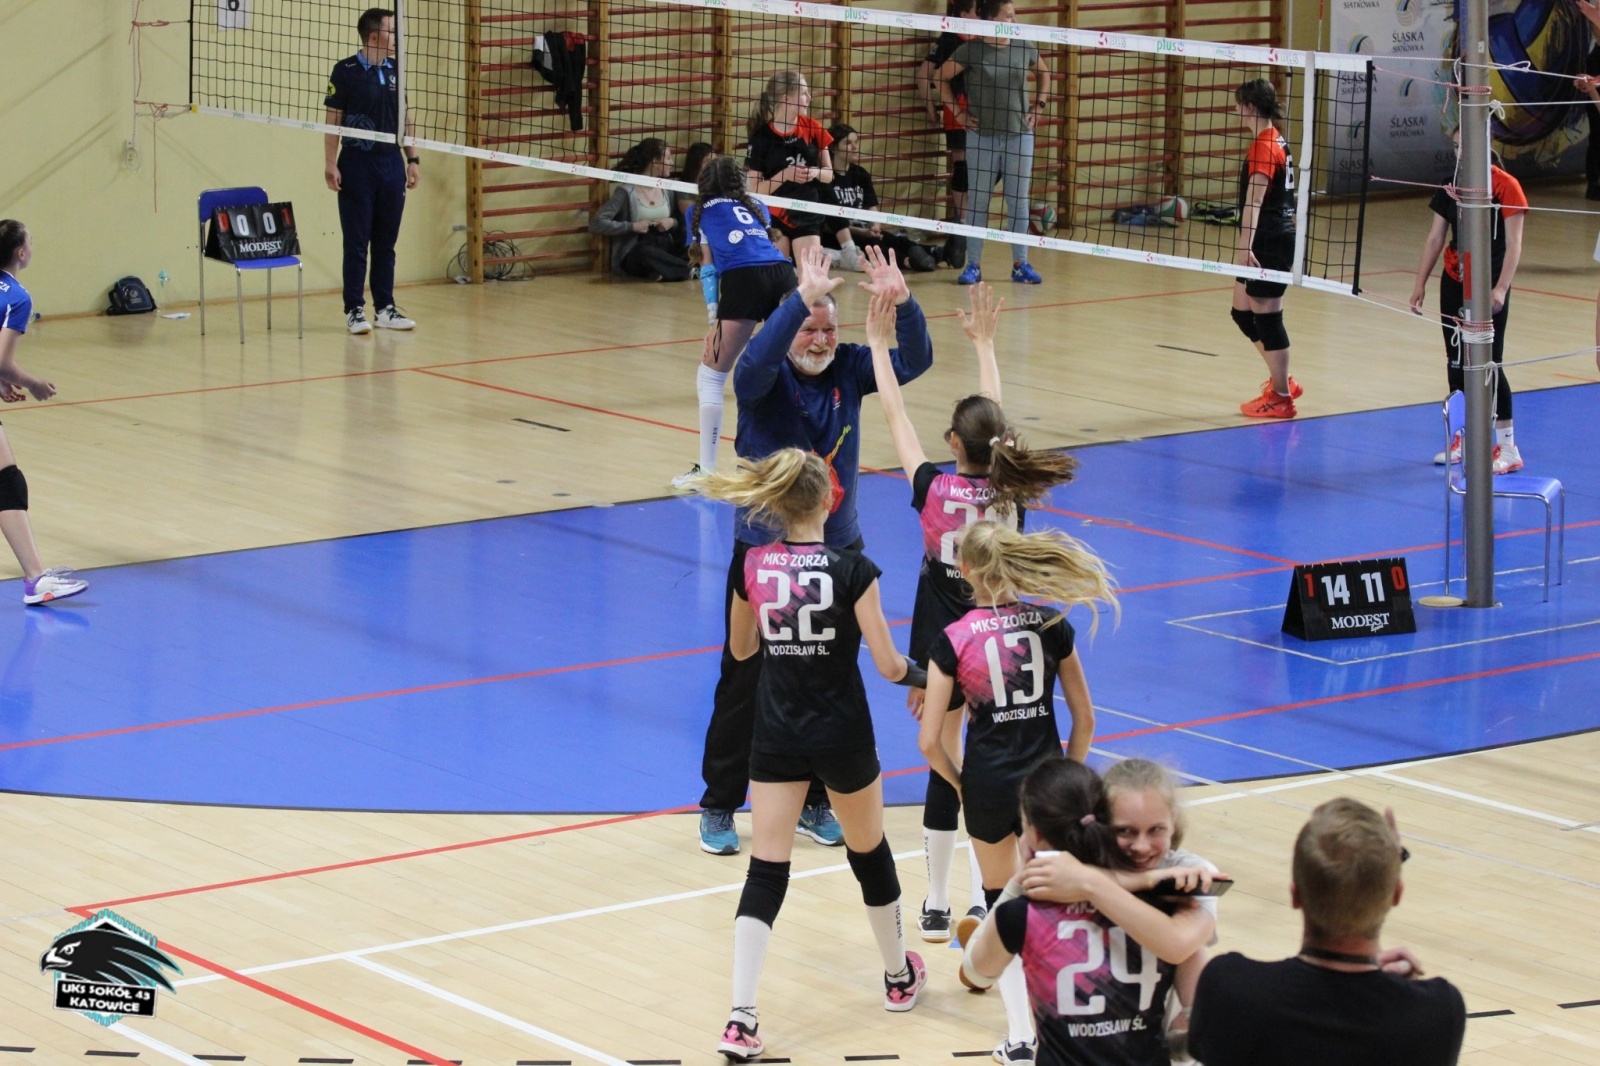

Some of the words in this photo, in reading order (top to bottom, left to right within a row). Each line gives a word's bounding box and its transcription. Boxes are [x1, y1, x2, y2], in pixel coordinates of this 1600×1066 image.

[845, 8, 862, 21] plus
[995, 22, 1014, 36] plus
[1157, 38, 1177, 53] plus
[236, 214, 249, 236] 0
[263, 211, 277, 235] 0
[733, 206, 754, 225] 6
[239, 240, 282, 253] MODEST
[950, 485, 973, 500] MKS
[763, 553, 788, 566] MKS
[790, 554, 829, 567] ZORZA
[1304, 573, 1315, 598] 1
[1321, 574, 1351, 606] 14
[1361, 571, 1386, 603] 11
[1391, 566, 1406, 590] 0
[757, 569, 836, 641] 22
[970, 618, 1000, 634] MKS
[1001, 611, 1044, 630] ZORZA
[1331, 613, 1390, 630] MODEST
[984, 630, 1045, 707] 13
[992, 706, 1037, 723] WODZISŁAW
[1057, 919, 1162, 1015] 24
[1068, 1018, 1131, 1038] WODZISŁAW
